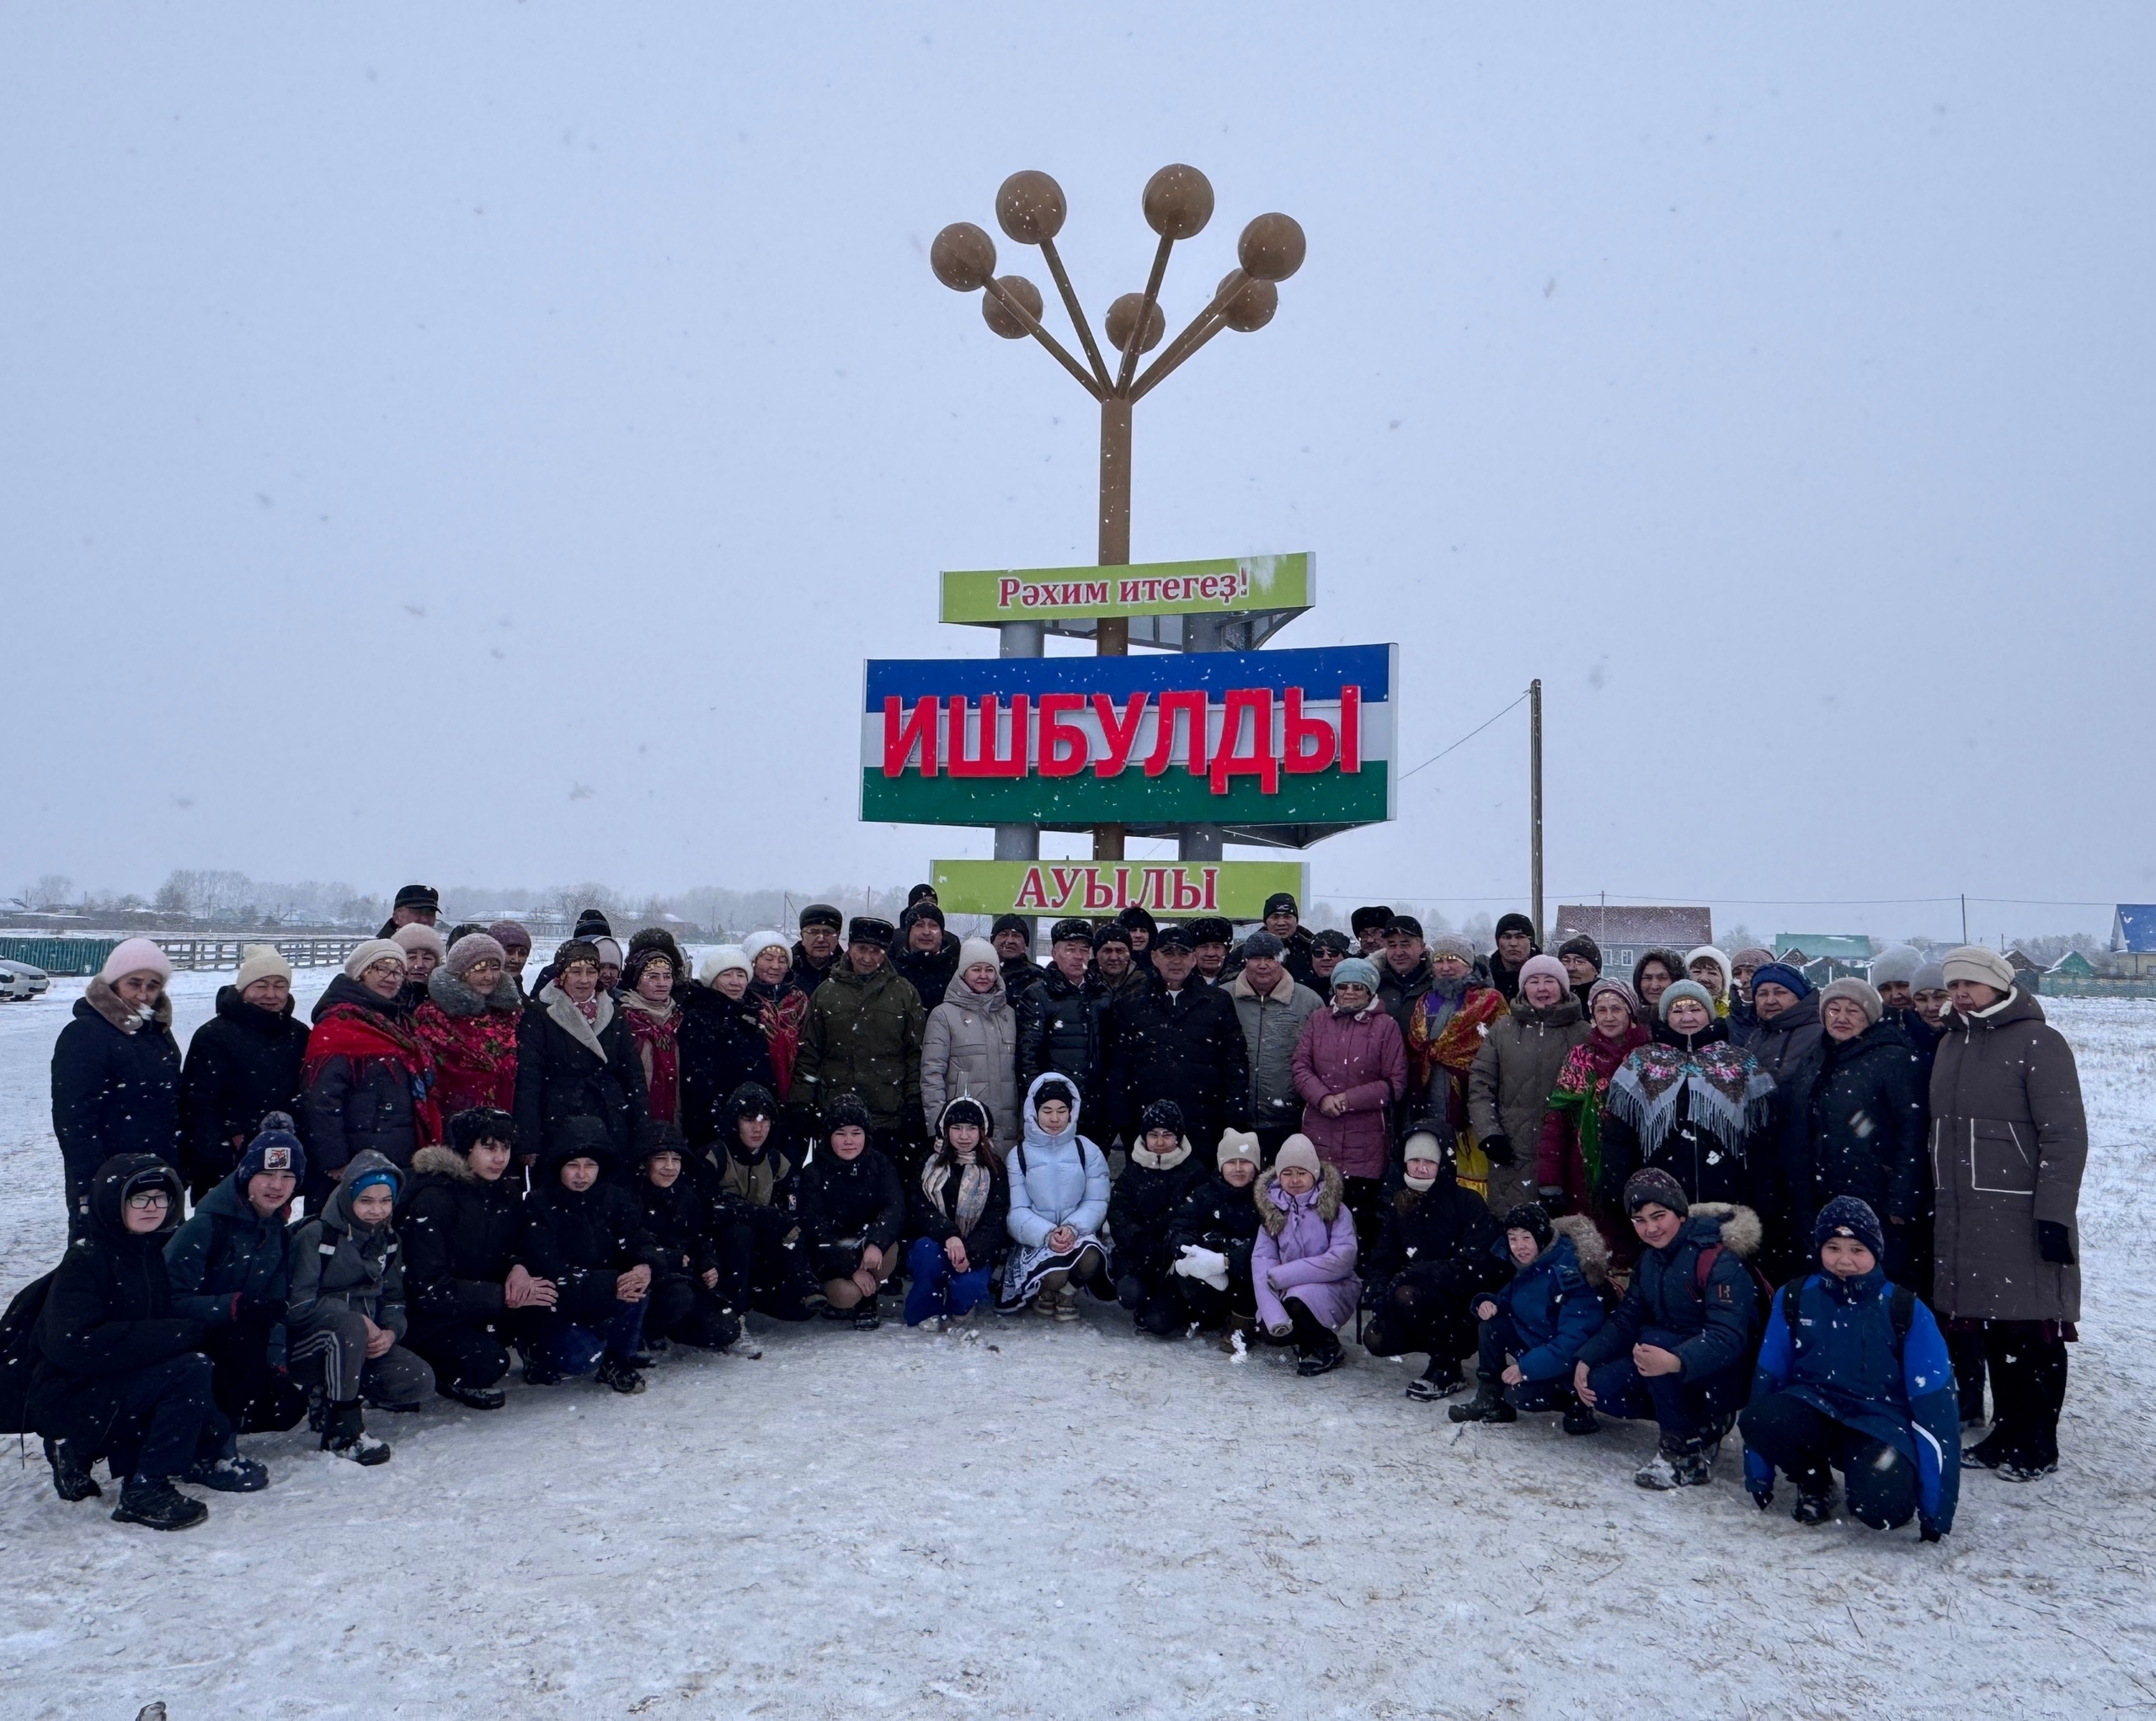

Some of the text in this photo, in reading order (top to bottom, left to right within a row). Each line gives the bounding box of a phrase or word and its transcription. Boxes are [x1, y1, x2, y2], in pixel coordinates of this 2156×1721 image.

[998, 578, 1109, 607] Рәхим
[883, 685, 1362, 794] ИШБУЛДЫ
[1014, 867, 1218, 909] АУЫЛЫ
